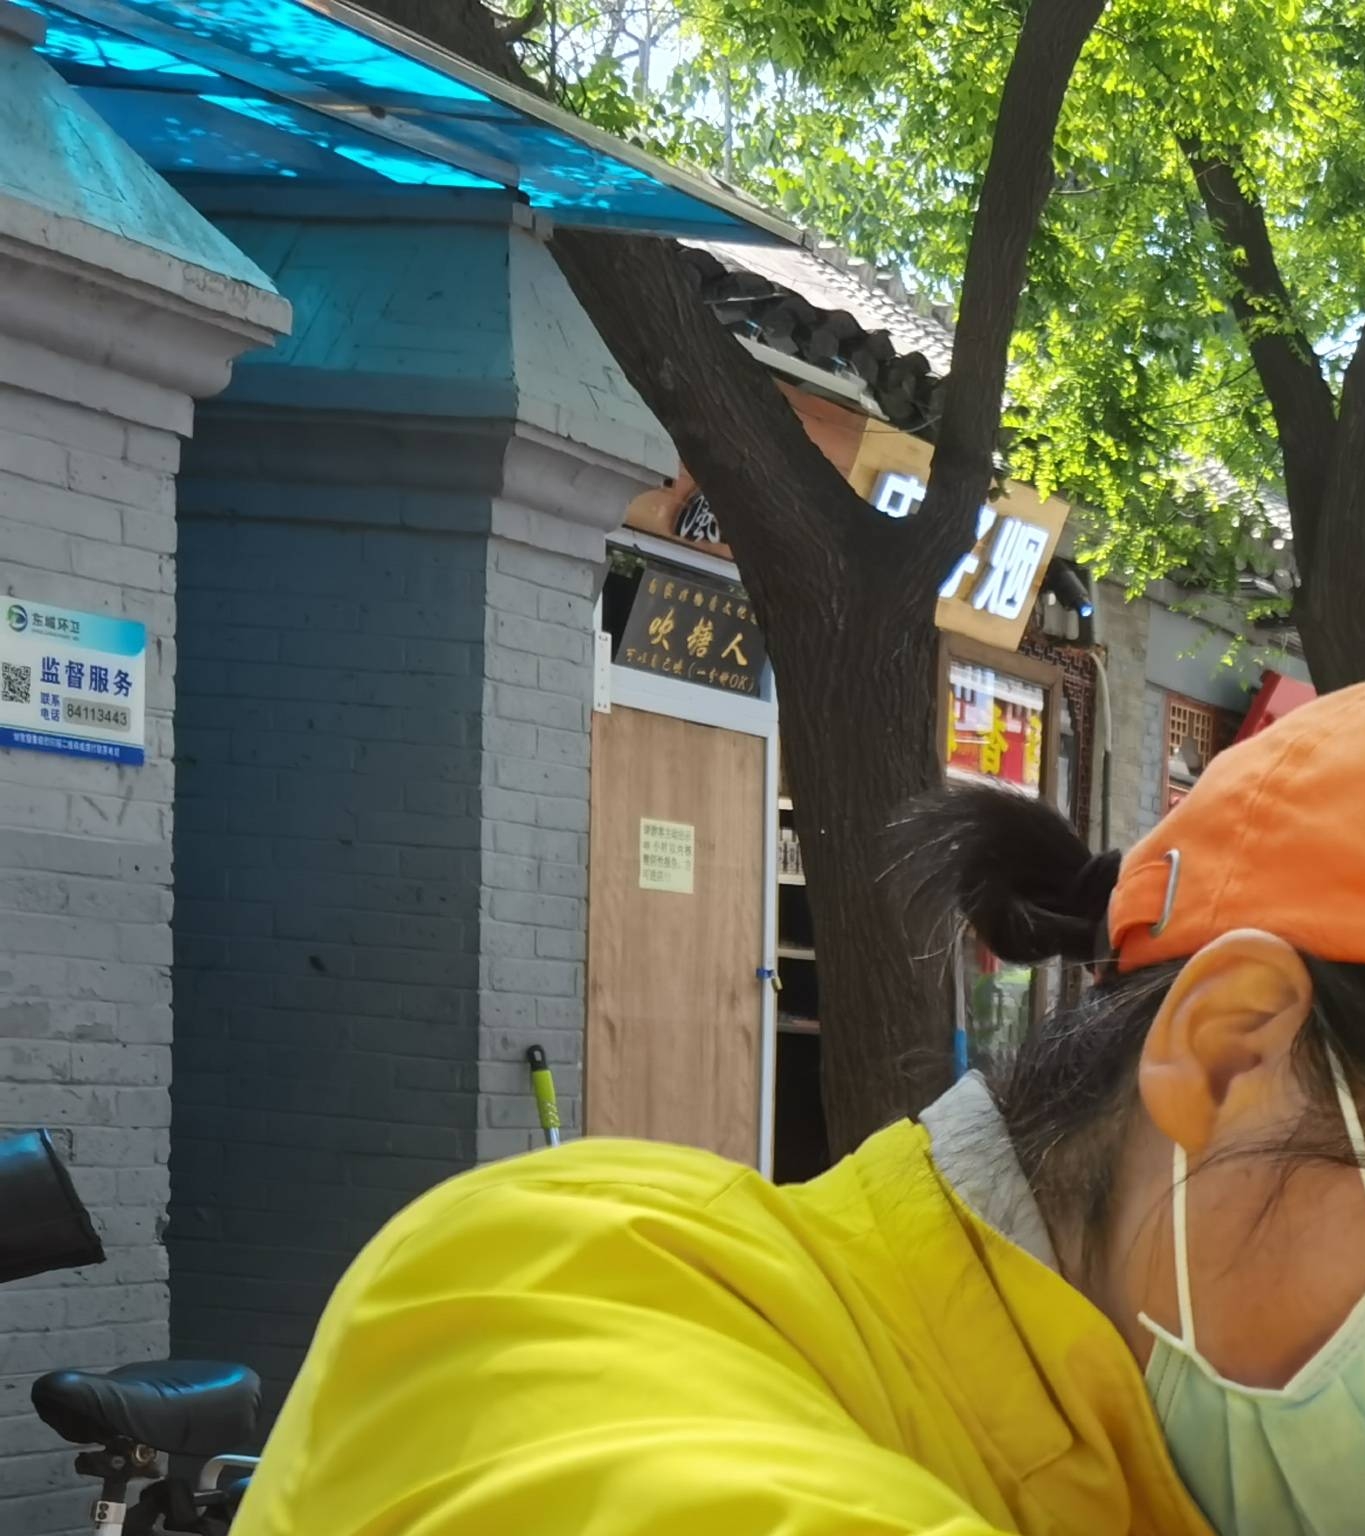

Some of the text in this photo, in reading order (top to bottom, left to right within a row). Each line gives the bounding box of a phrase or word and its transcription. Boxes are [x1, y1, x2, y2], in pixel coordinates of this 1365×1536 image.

[40, 656, 133, 697] 监督服务
[40, 692, 60, 706] 联系
[40, 708, 60, 722] 电话
[66, 703, 128, 726] 84113443
